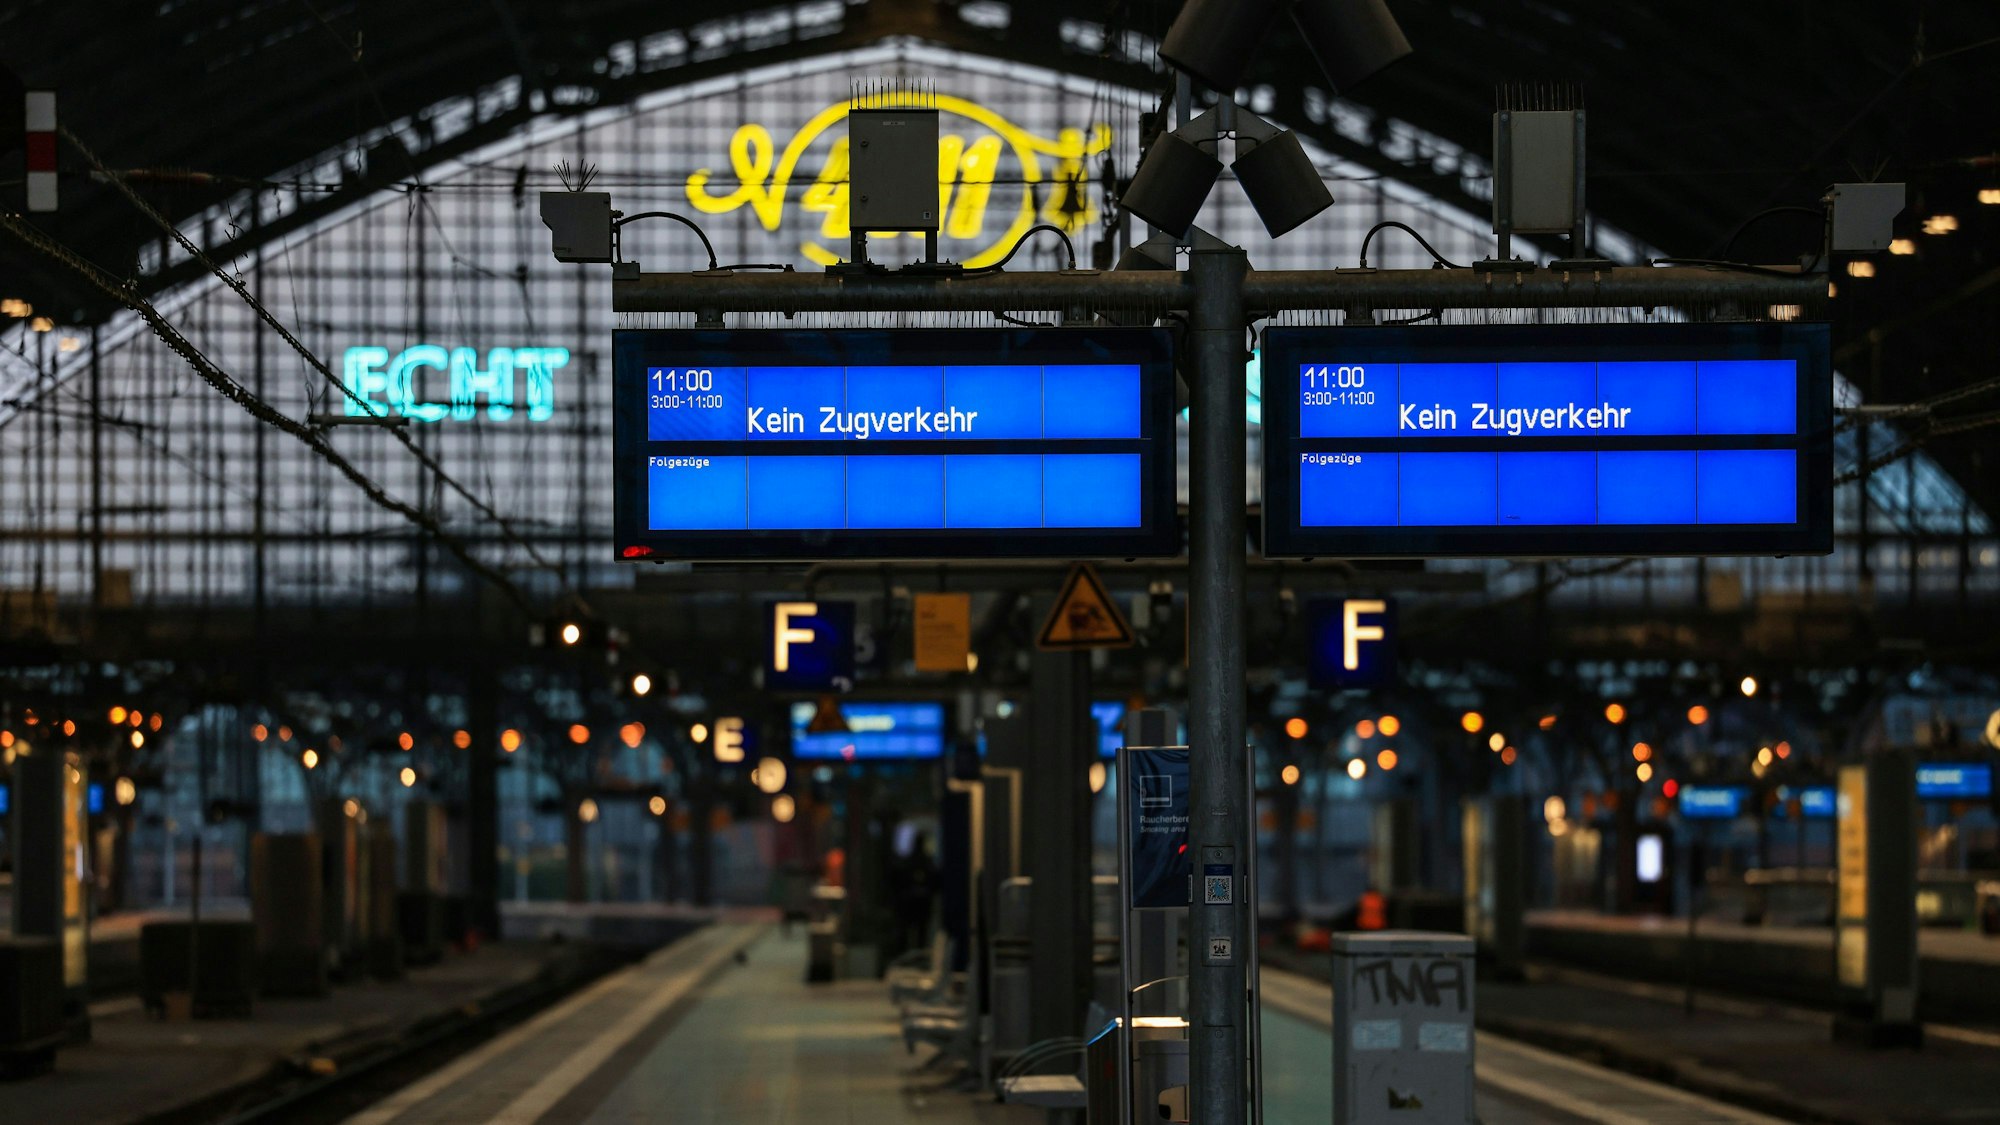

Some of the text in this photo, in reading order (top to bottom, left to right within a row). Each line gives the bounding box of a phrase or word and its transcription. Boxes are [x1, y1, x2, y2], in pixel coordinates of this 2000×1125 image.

[343, 345, 570, 422] ECHT
[652, 369, 712, 392] 11:00
[1304, 366, 1365, 388] 11:00
[651, 395, 723, 408] 3:00-11:00
[1303, 391, 1375, 406] 3:00-11:00
[748, 406, 978, 440] Kein Zugverkehr
[1400, 402, 1632, 436] Kein Zugverkehr
[649, 456, 710, 469] Folgezüge
[1301, 452, 1362, 467] Folgezüge
[774, 602, 818, 672] F
[1343, 599, 1387, 671] F
[714, 717, 745, 763] E
[1140, 826, 1170, 834] Smoking
